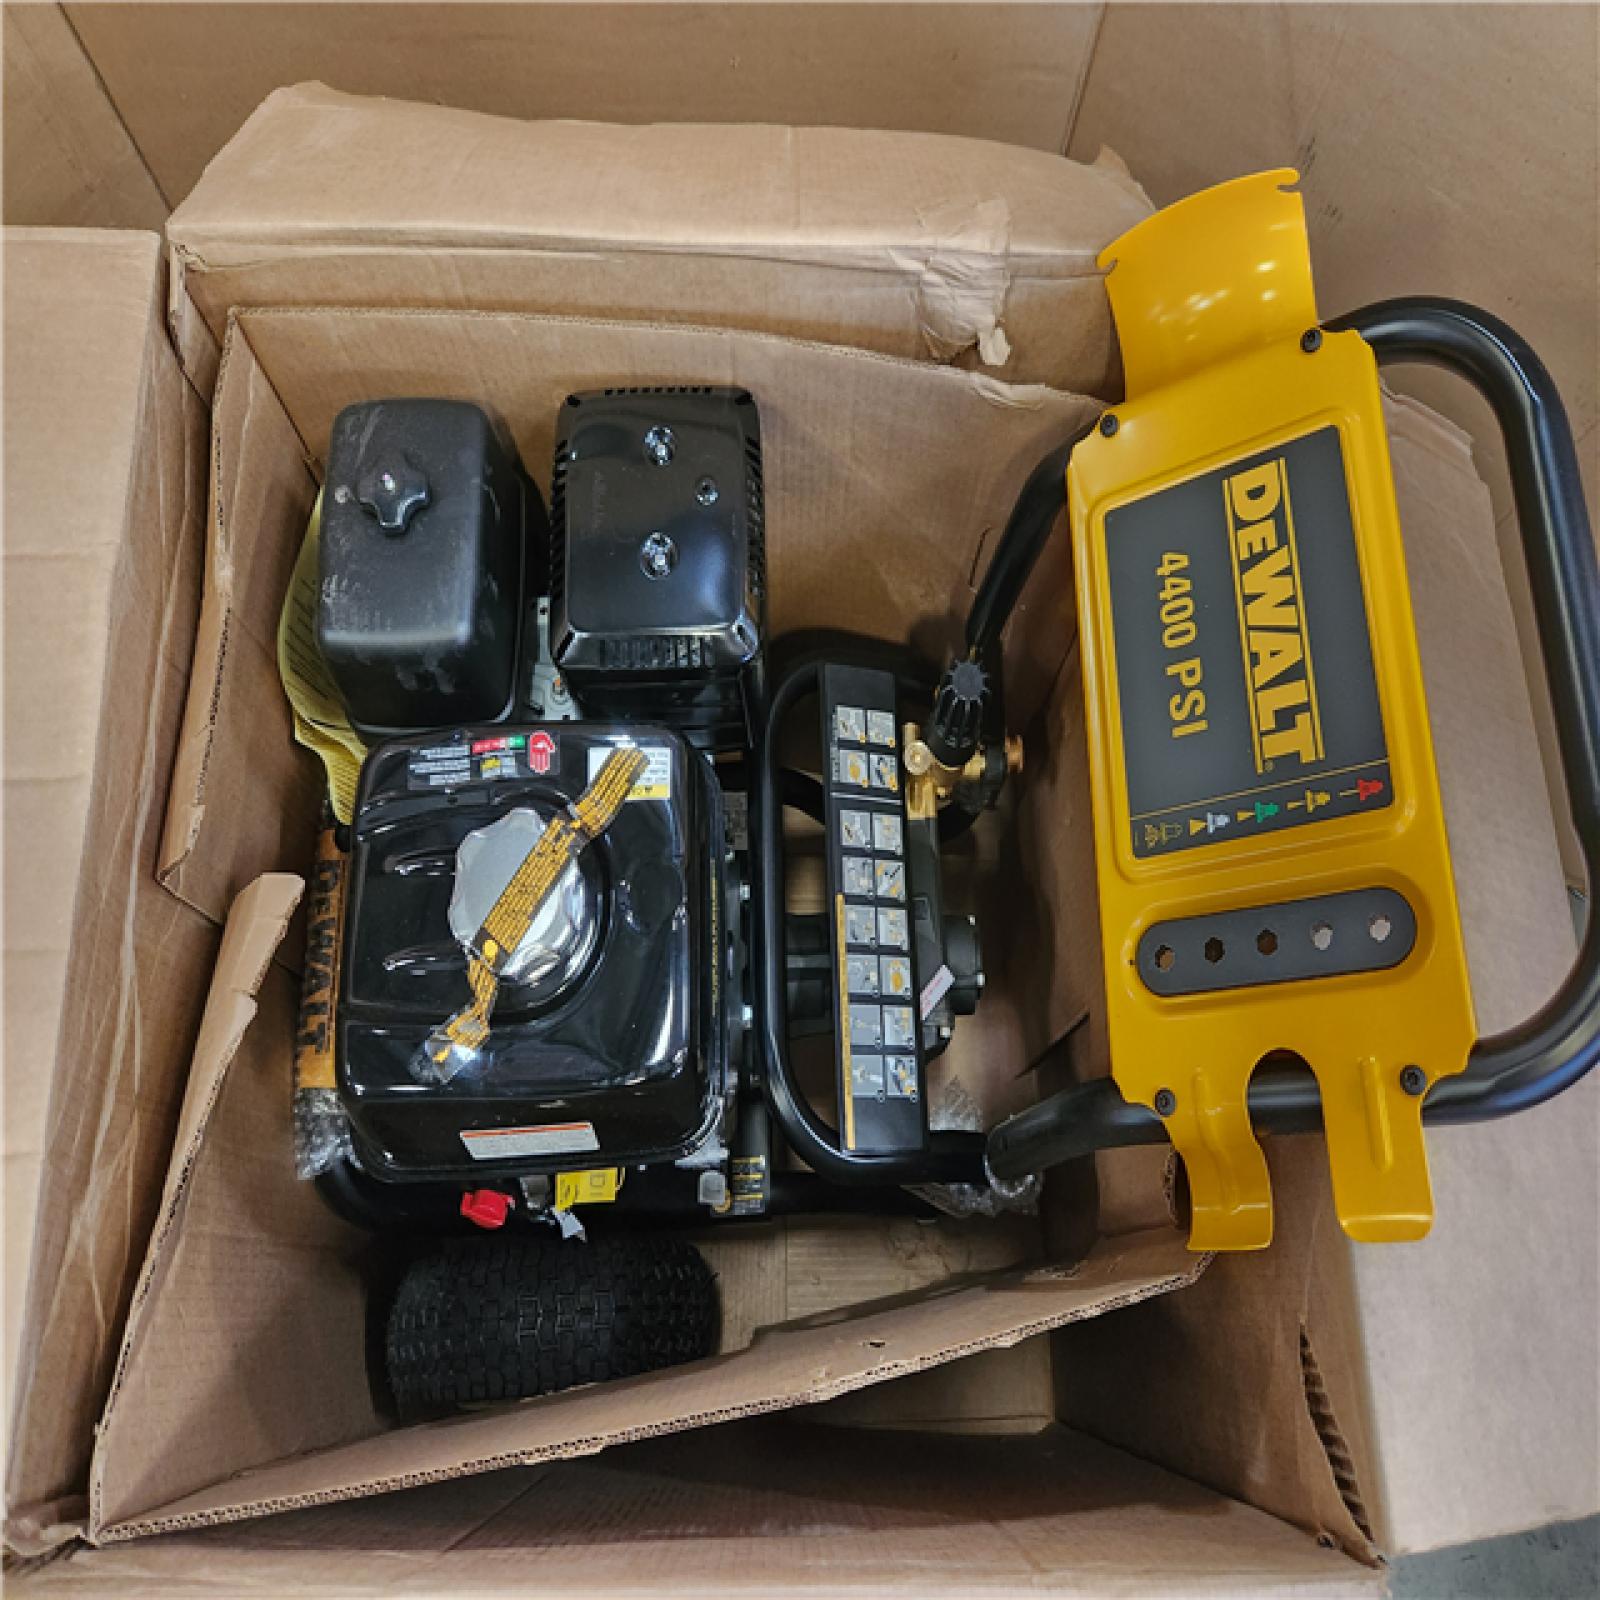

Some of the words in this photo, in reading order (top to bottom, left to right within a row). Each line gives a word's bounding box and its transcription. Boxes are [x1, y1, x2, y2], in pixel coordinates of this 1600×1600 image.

[1156, 554, 1196, 648] 4400
[1226, 460, 1317, 766] DEWALT
[1166, 657, 1208, 738] PSI
